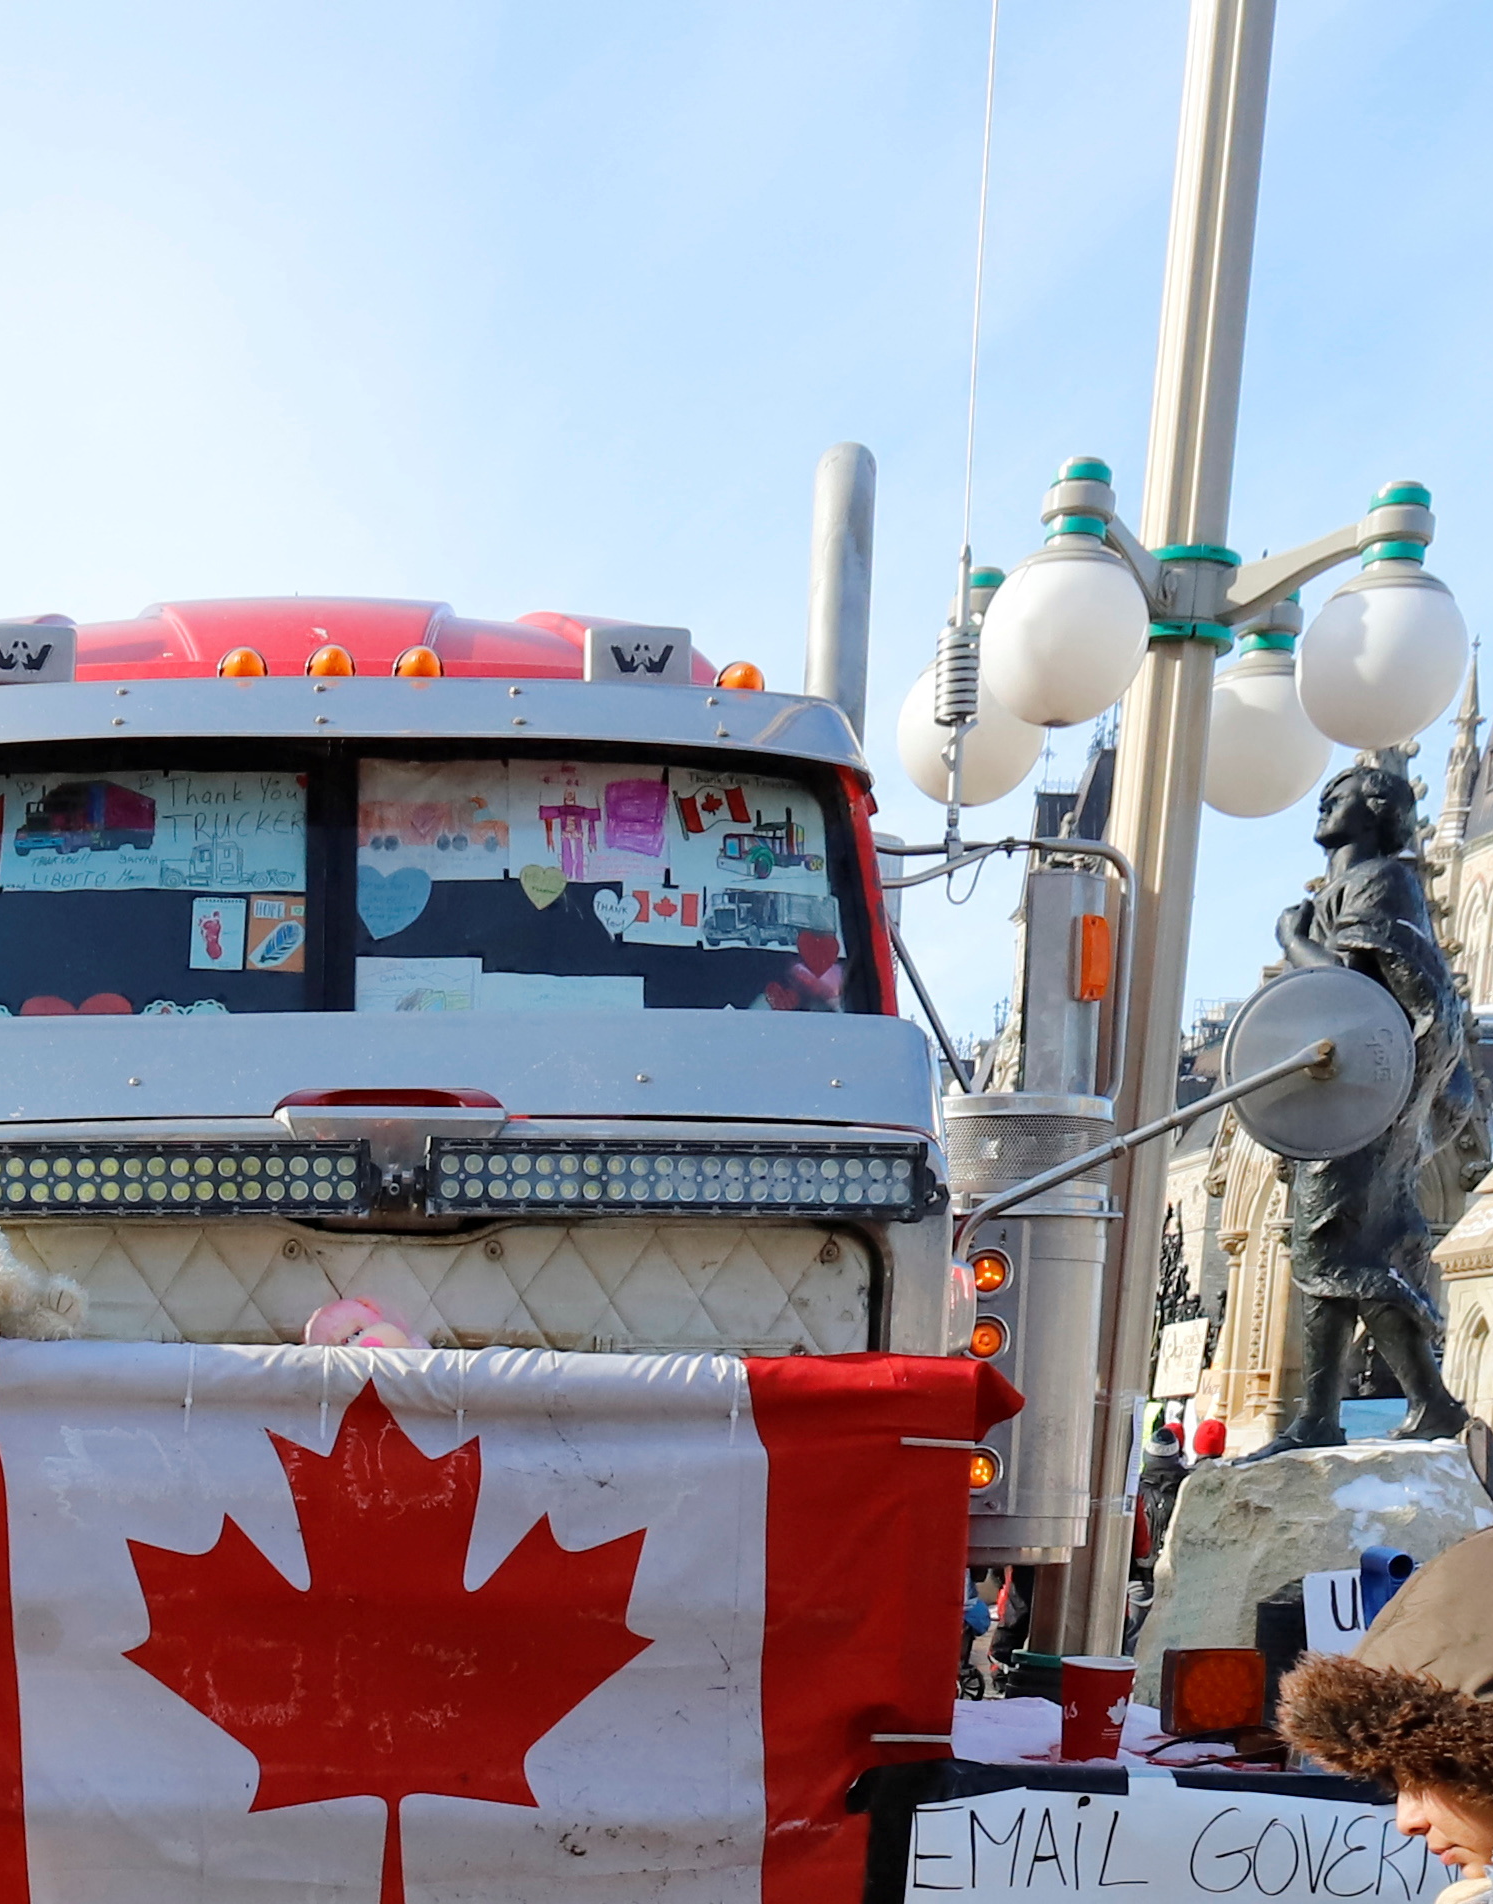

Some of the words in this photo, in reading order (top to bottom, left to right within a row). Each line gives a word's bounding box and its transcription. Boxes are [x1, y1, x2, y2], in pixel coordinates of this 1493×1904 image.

[167, 777, 245, 807] Thank
[260, 777, 297, 802] You
[595, 901, 629, 915] THANK
